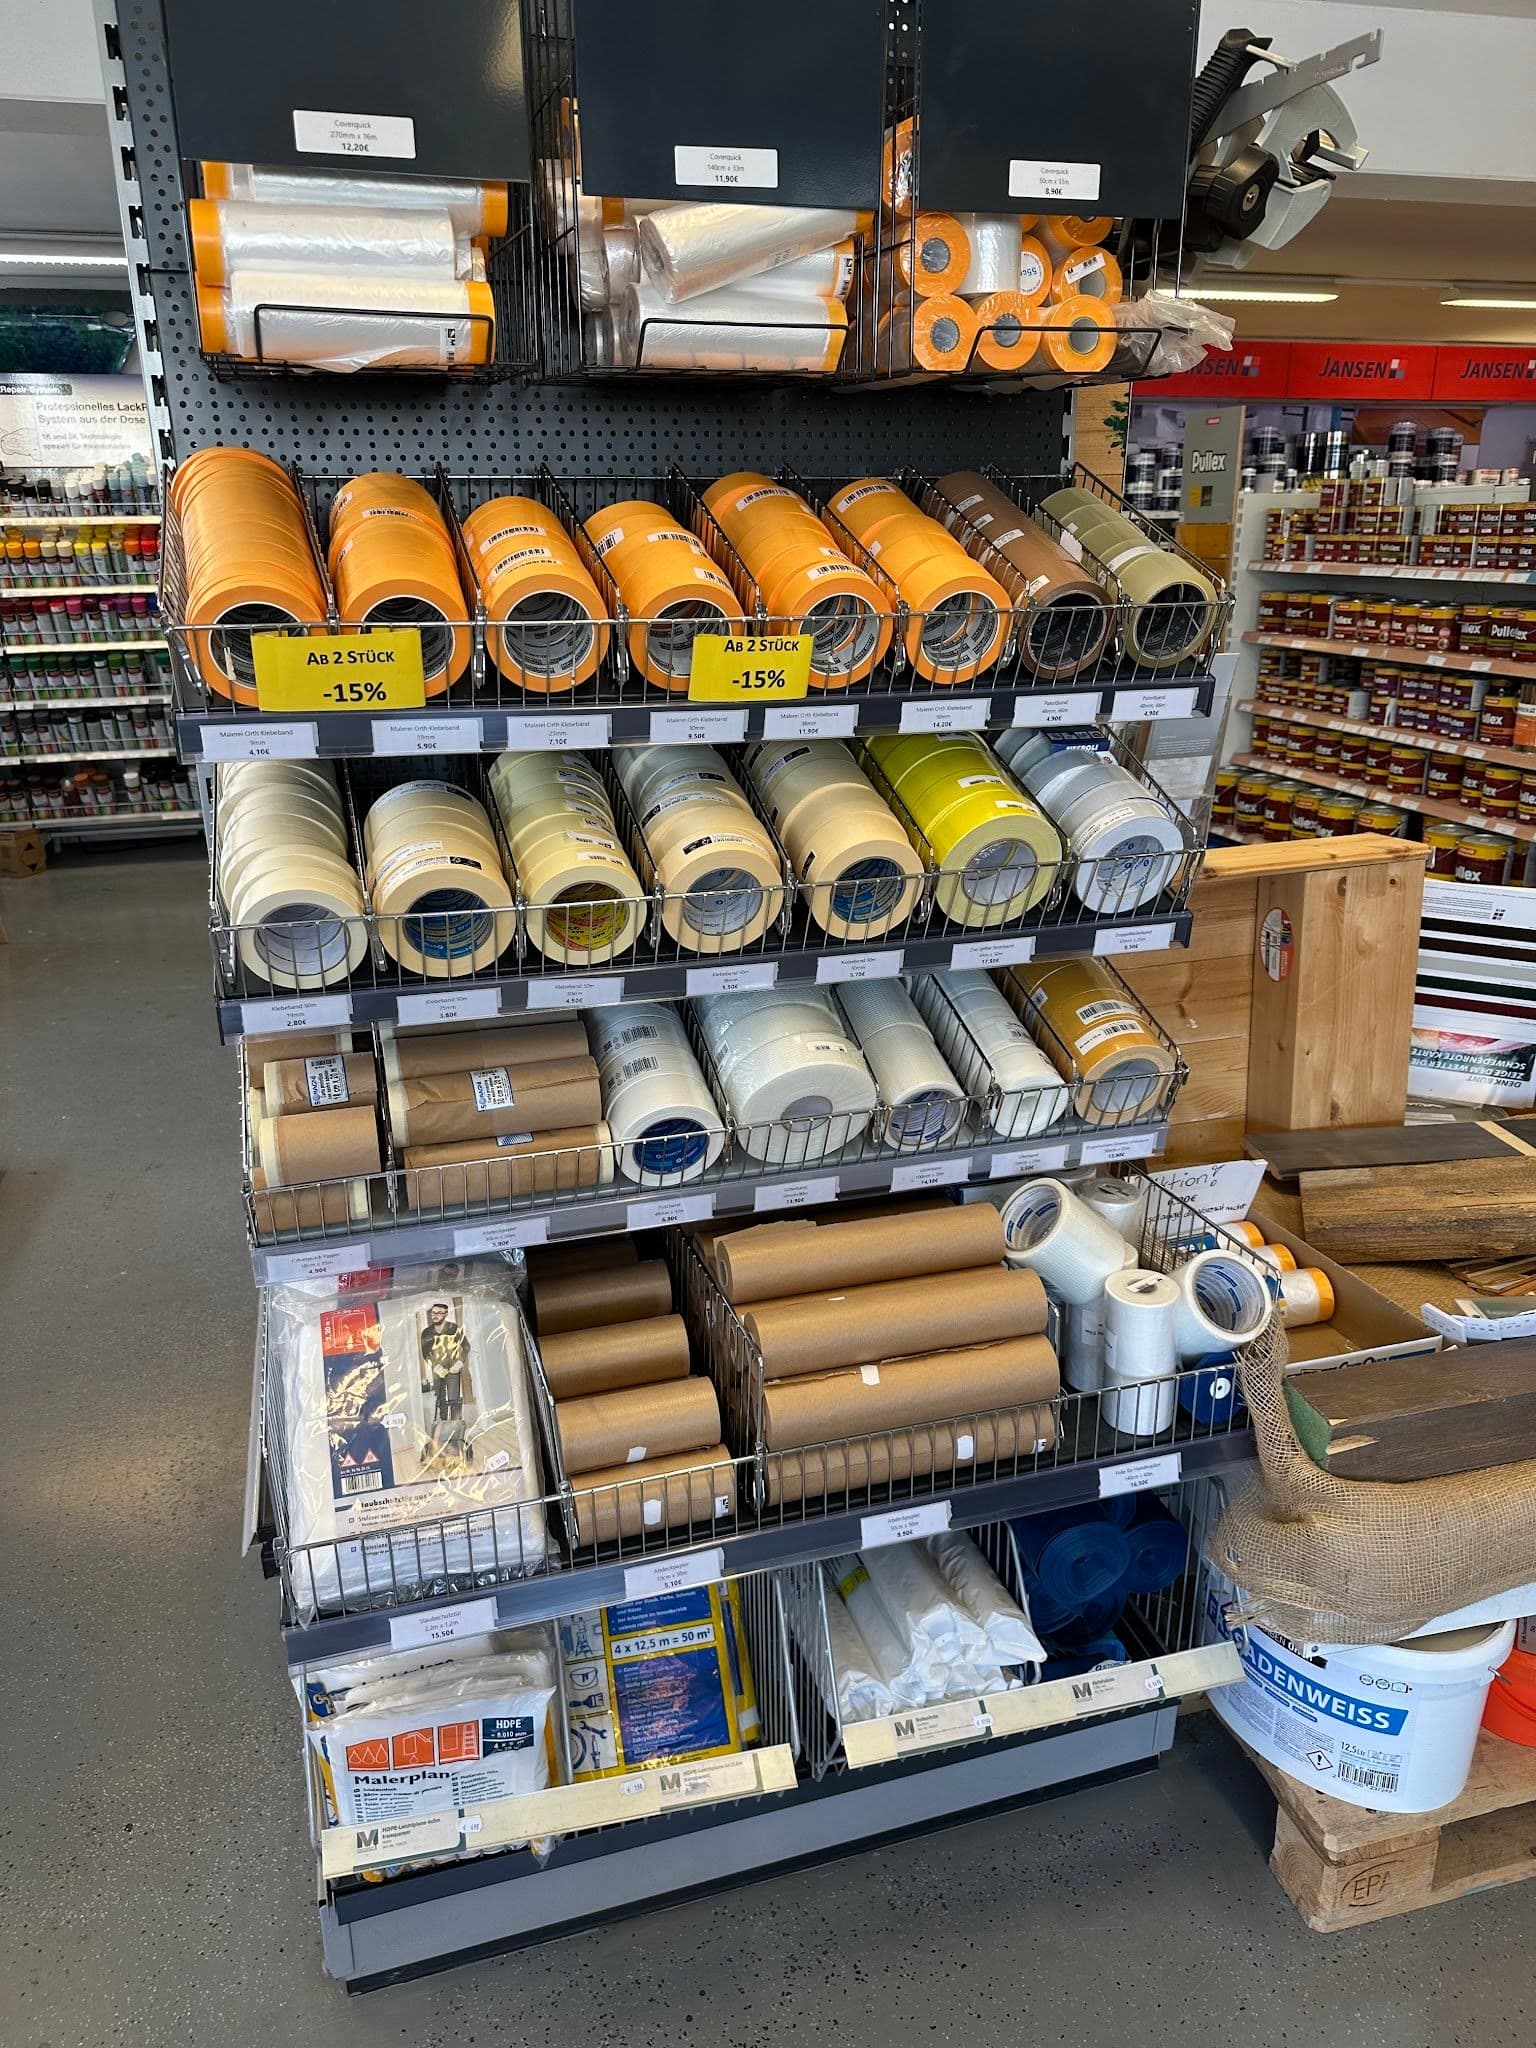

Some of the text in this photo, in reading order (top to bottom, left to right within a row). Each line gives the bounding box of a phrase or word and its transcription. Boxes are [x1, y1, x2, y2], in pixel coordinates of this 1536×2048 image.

[334, 119, 372, 129] Coverquick
[342, 142, 369, 153] 12,20€
[710, 153, 742, 162] Coverquick
[1040, 167, 1069, 176] Coverquick
[715, 175, 739, 184] 11,90€
[1318, 357, 1388, 379] JANSEN
[1459, 359, 1527, 379] JANSEN
[36, 402, 114, 412] Professionelles
[38, 414, 146, 426] System aus der Dose
[1191, 451, 1227, 472] Pullex
[747, 639, 755, 652] 2
[332, 651, 344, 664] 2
[731, 669, 786, 689] -15%
[323, 681, 387, 702] -15%
[220, 731, 244, 739] Malerei
[417, 742, 437, 750] 5,90€
[549, 738, 568, 746] 7,10€
[249, 748, 270, 757] 4,10€
[1493, 1069, 1525, 1080] ZEIGE
[664, 1579, 682, 1589] 5,10€
[419, 1610, 462, 1624] Staubschutztür
[431, 1629, 455, 1639] 15,50€
[614, 1644, 621, 1655] 4
[624, 1645, 631, 1653] x
[635, 1639, 656, 1652] 12,5
[659, 1637, 670, 1647] m
[681, 1631, 695, 1642] 50
[696, 1627, 711, 1640] m²
[495, 1718, 522, 1729] HDPE
